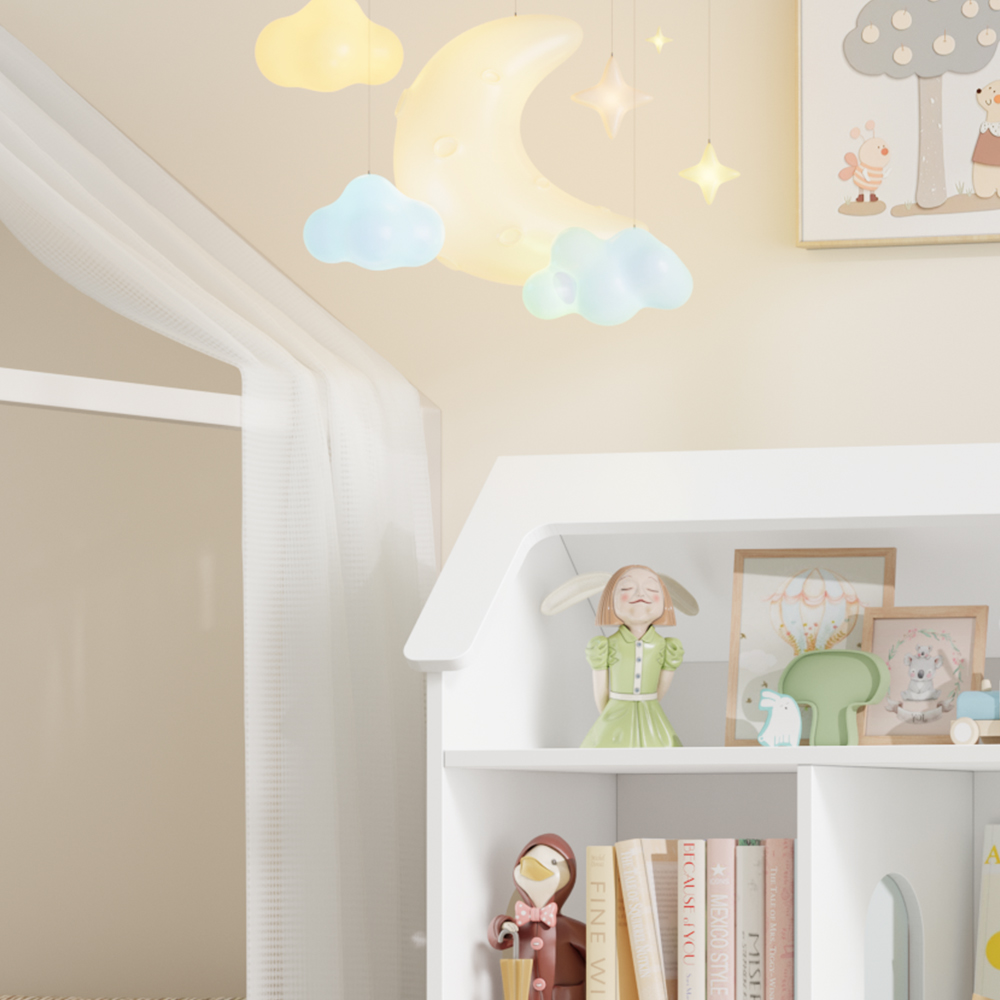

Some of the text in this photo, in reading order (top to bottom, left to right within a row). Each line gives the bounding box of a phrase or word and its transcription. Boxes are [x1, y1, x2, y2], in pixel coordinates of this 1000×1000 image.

[683, 842, 696, 966] BECAUSE of YOU
[769, 866, 778, 884] THE
[769, 885, 778, 908] TALE
[590, 881, 606, 944] FINE
[710, 894, 729, 996] MEXICO STYLE
